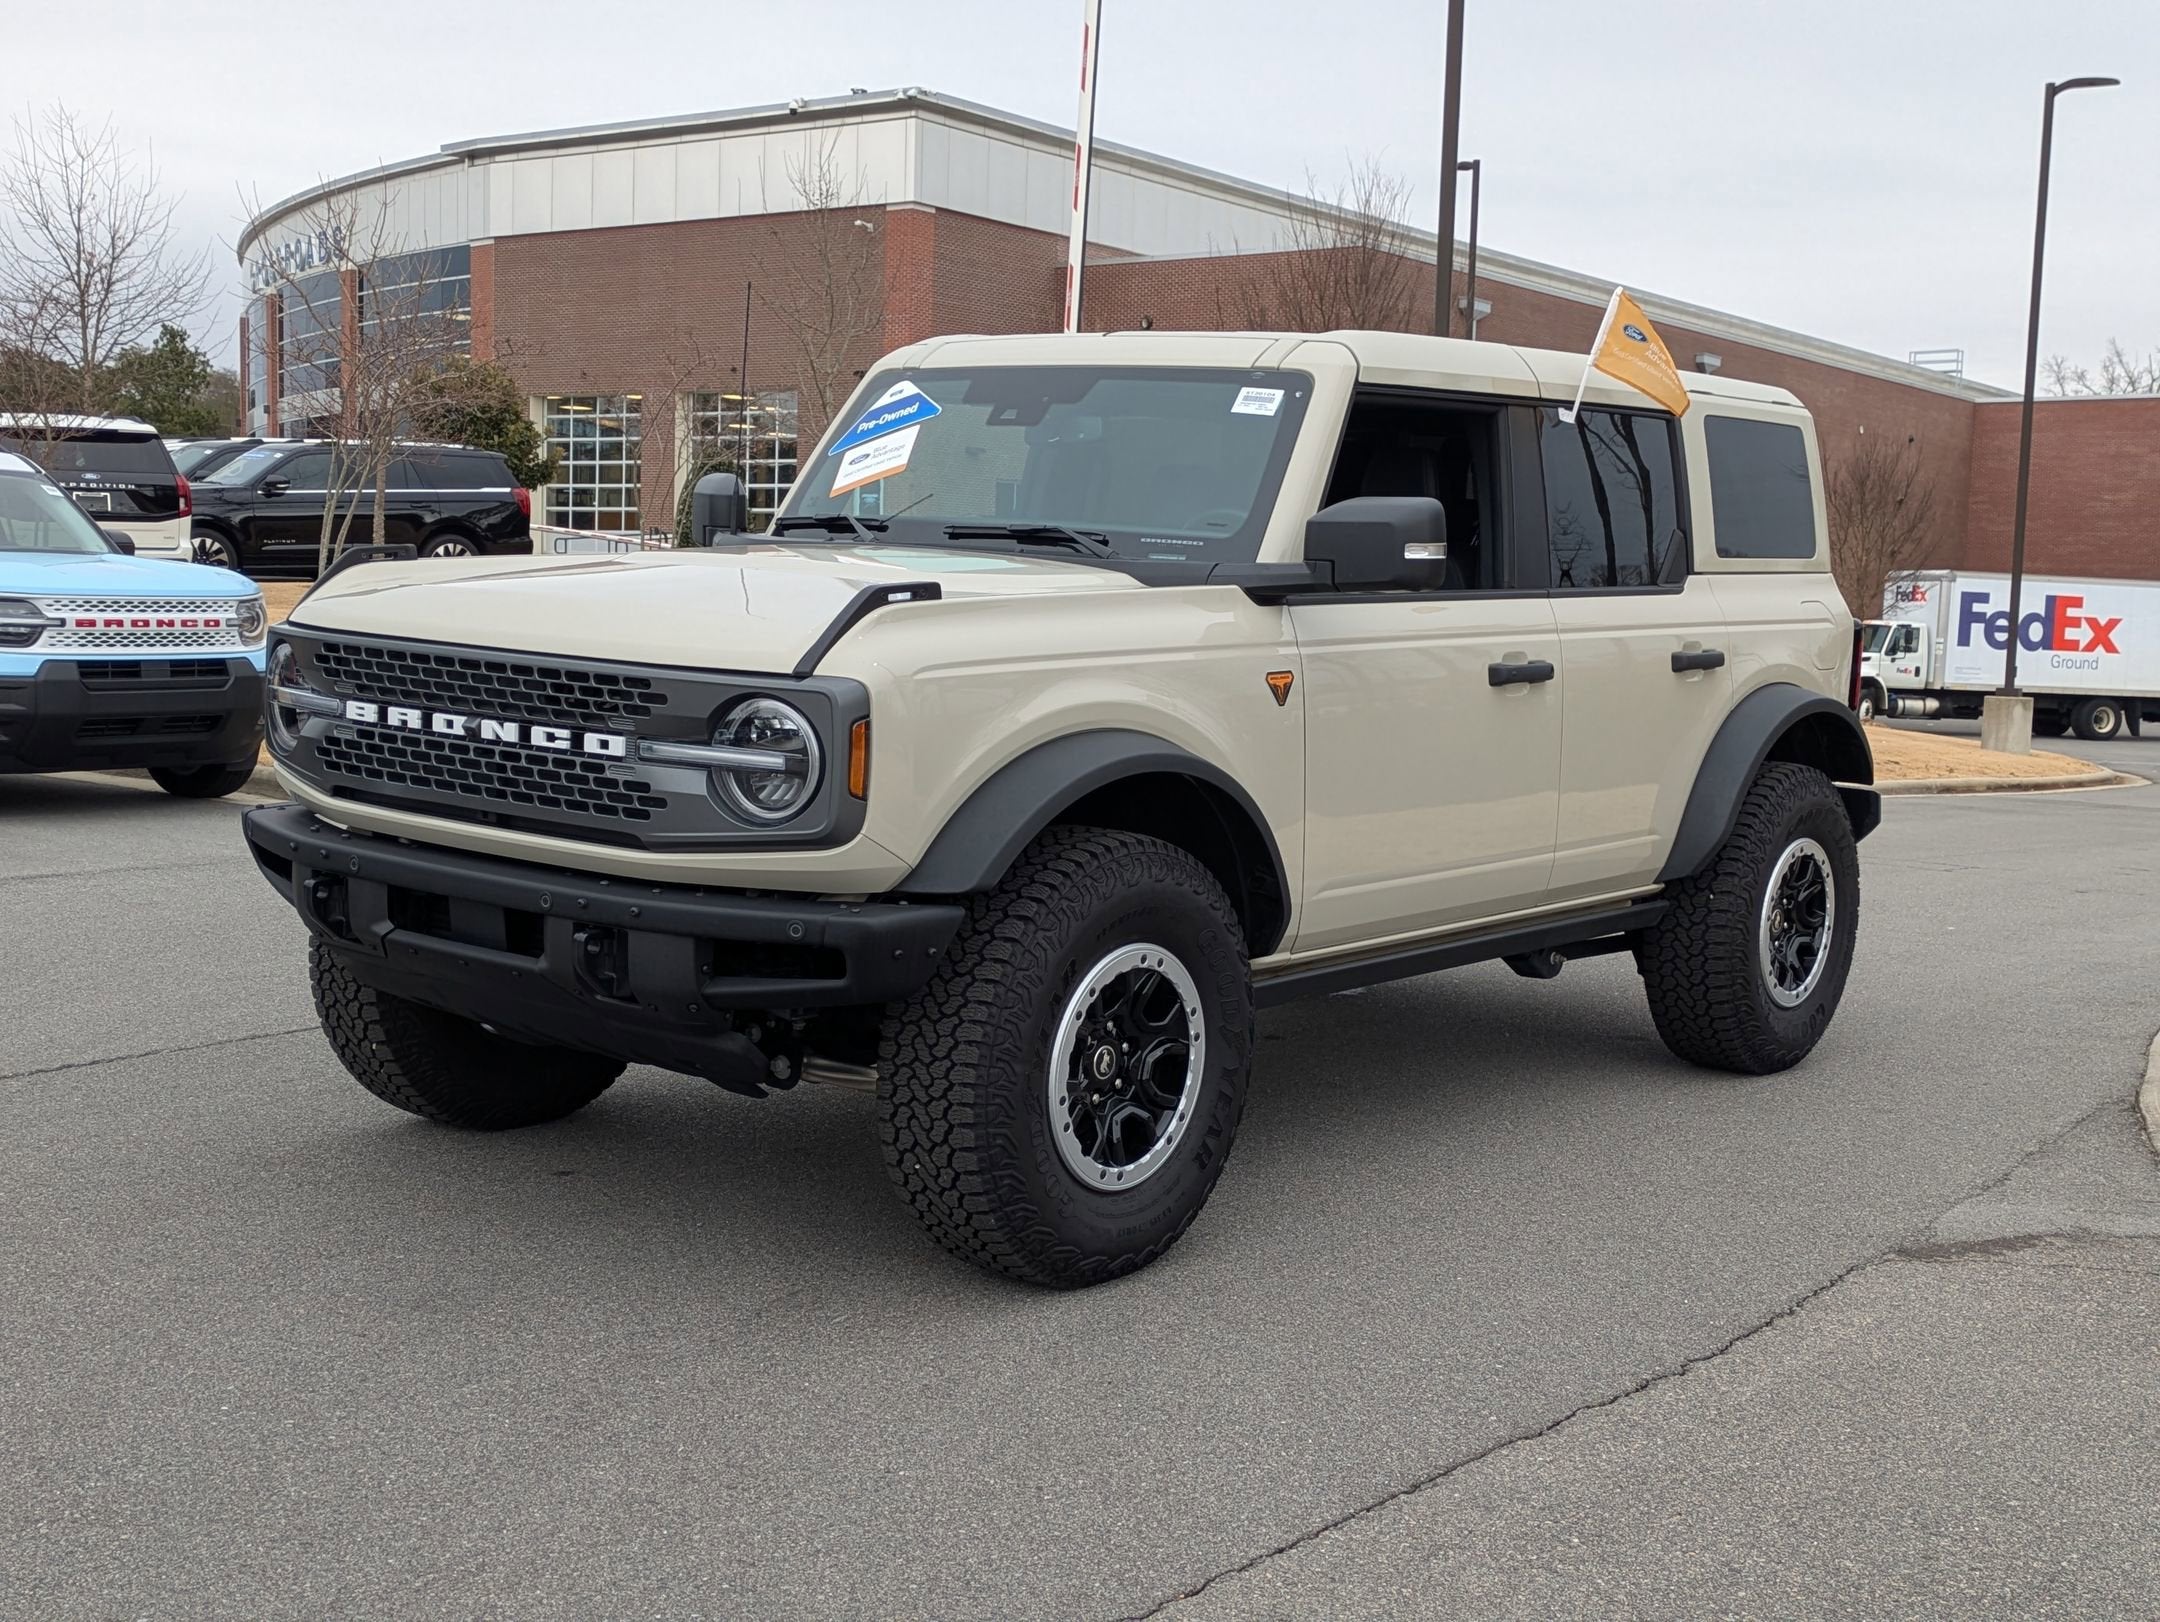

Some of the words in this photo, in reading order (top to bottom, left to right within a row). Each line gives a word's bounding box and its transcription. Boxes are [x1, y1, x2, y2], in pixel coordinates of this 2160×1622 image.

[857, 402, 920, 434] Pre-Owned
[1896, 584, 1927, 602] FedEx
[75, 619, 221, 628] BRONCO
[1957, 591, 2123, 654] FedEx
[2051, 654, 2099, 671] Ground
[346, 700, 626, 757] BRONCO
[1197, 929, 1245, 1171] GOODYEAR
